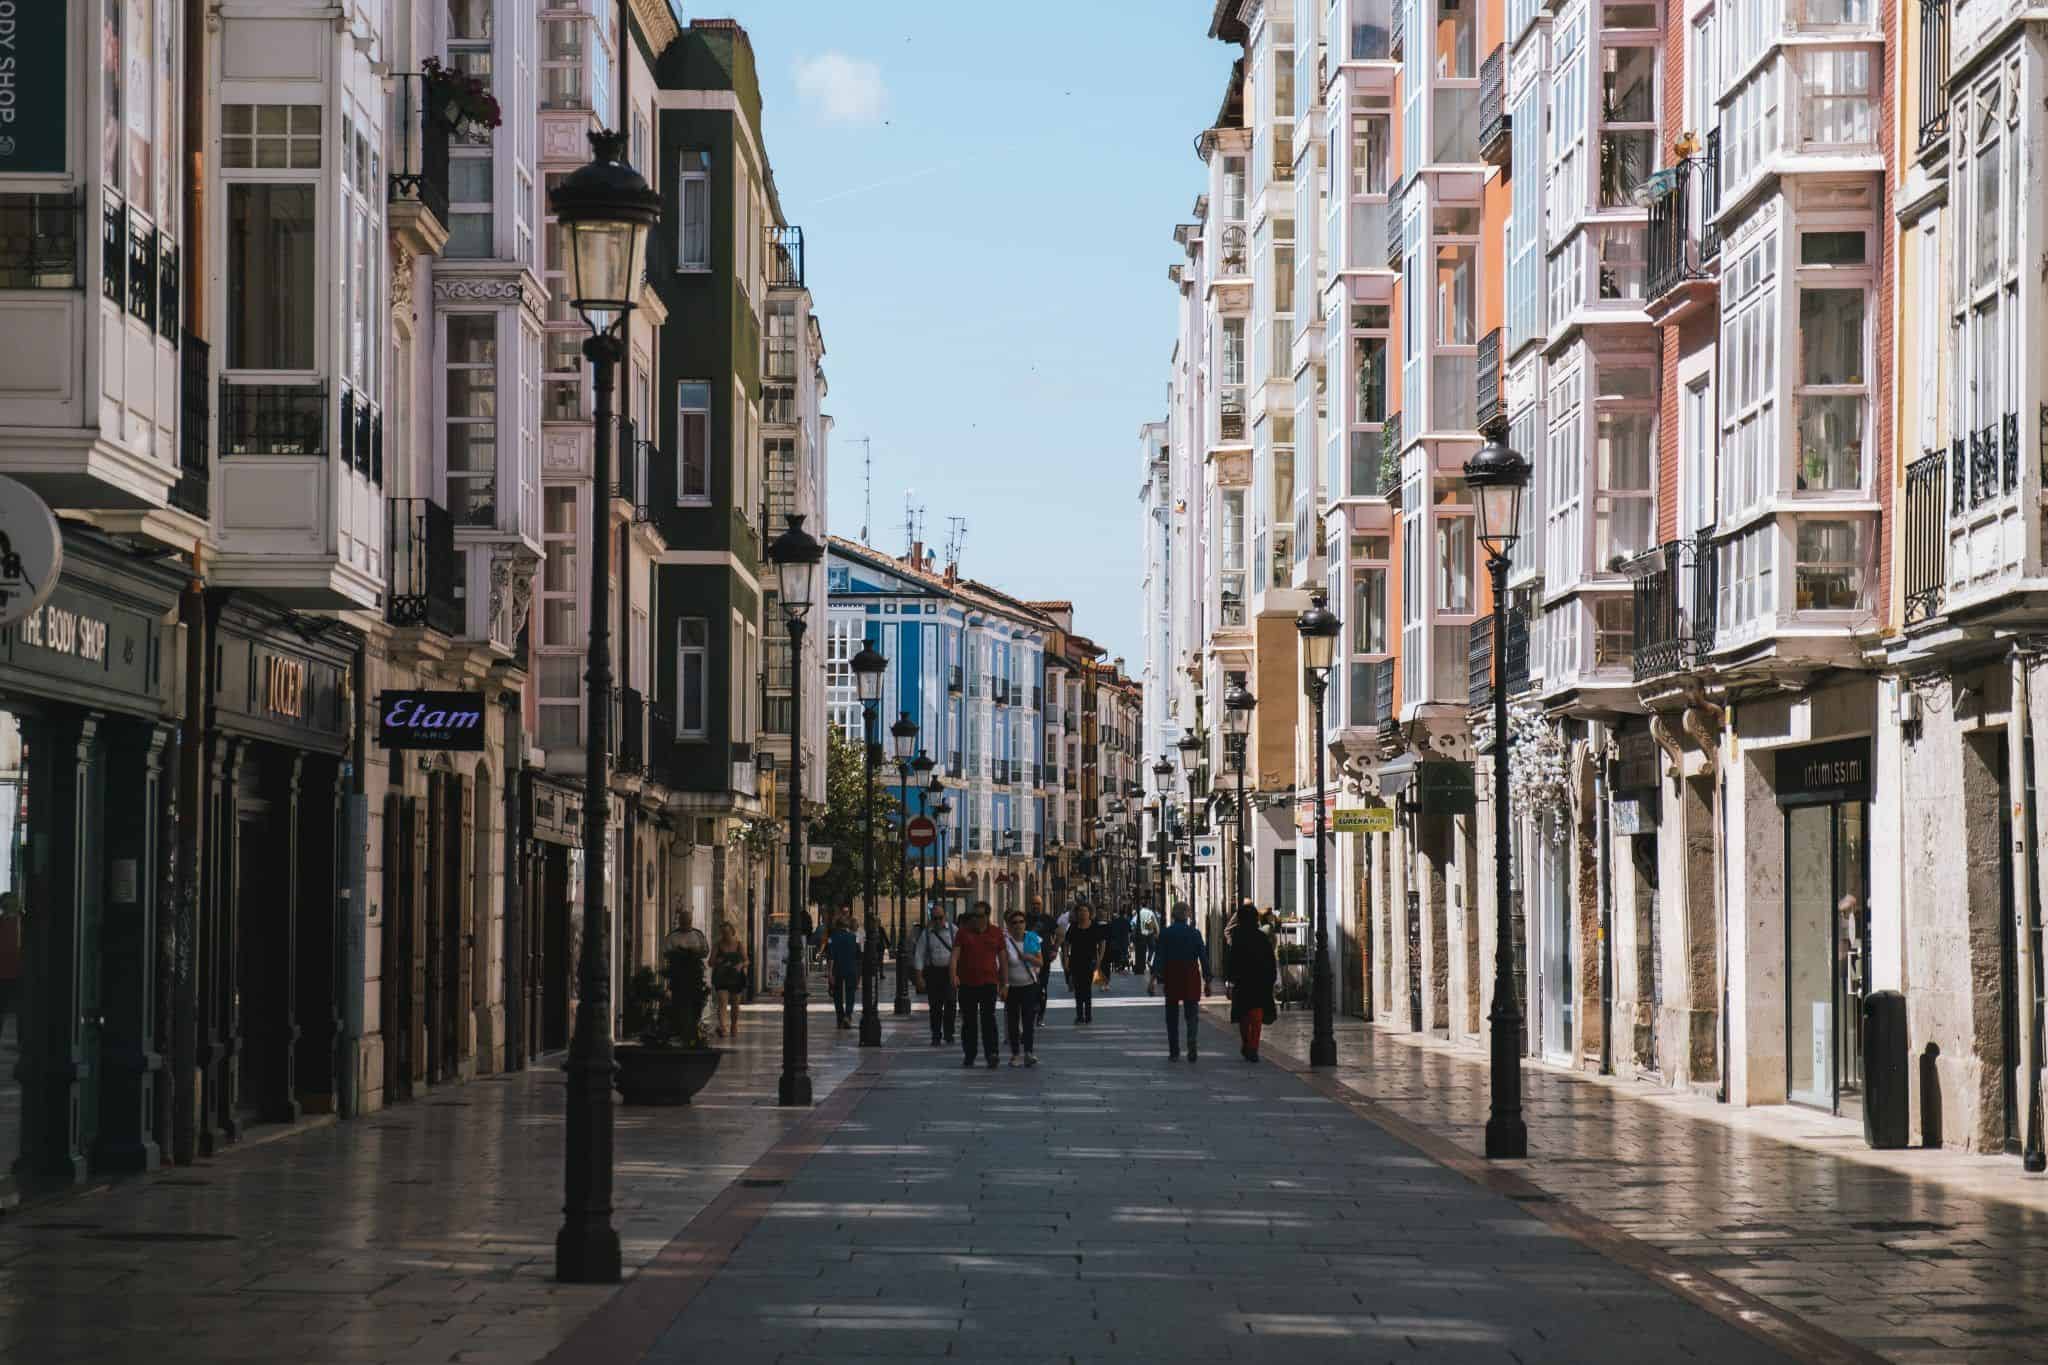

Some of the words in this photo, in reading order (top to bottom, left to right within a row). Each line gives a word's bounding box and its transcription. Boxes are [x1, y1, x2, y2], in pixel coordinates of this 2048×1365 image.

[0, 57, 16, 122] SHOP
[48, 606, 77, 656] BODY
[80, 616, 106, 661] SHOP
[385, 699, 480, 728] Etam
[1804, 760, 1863, 786] intimissimi
